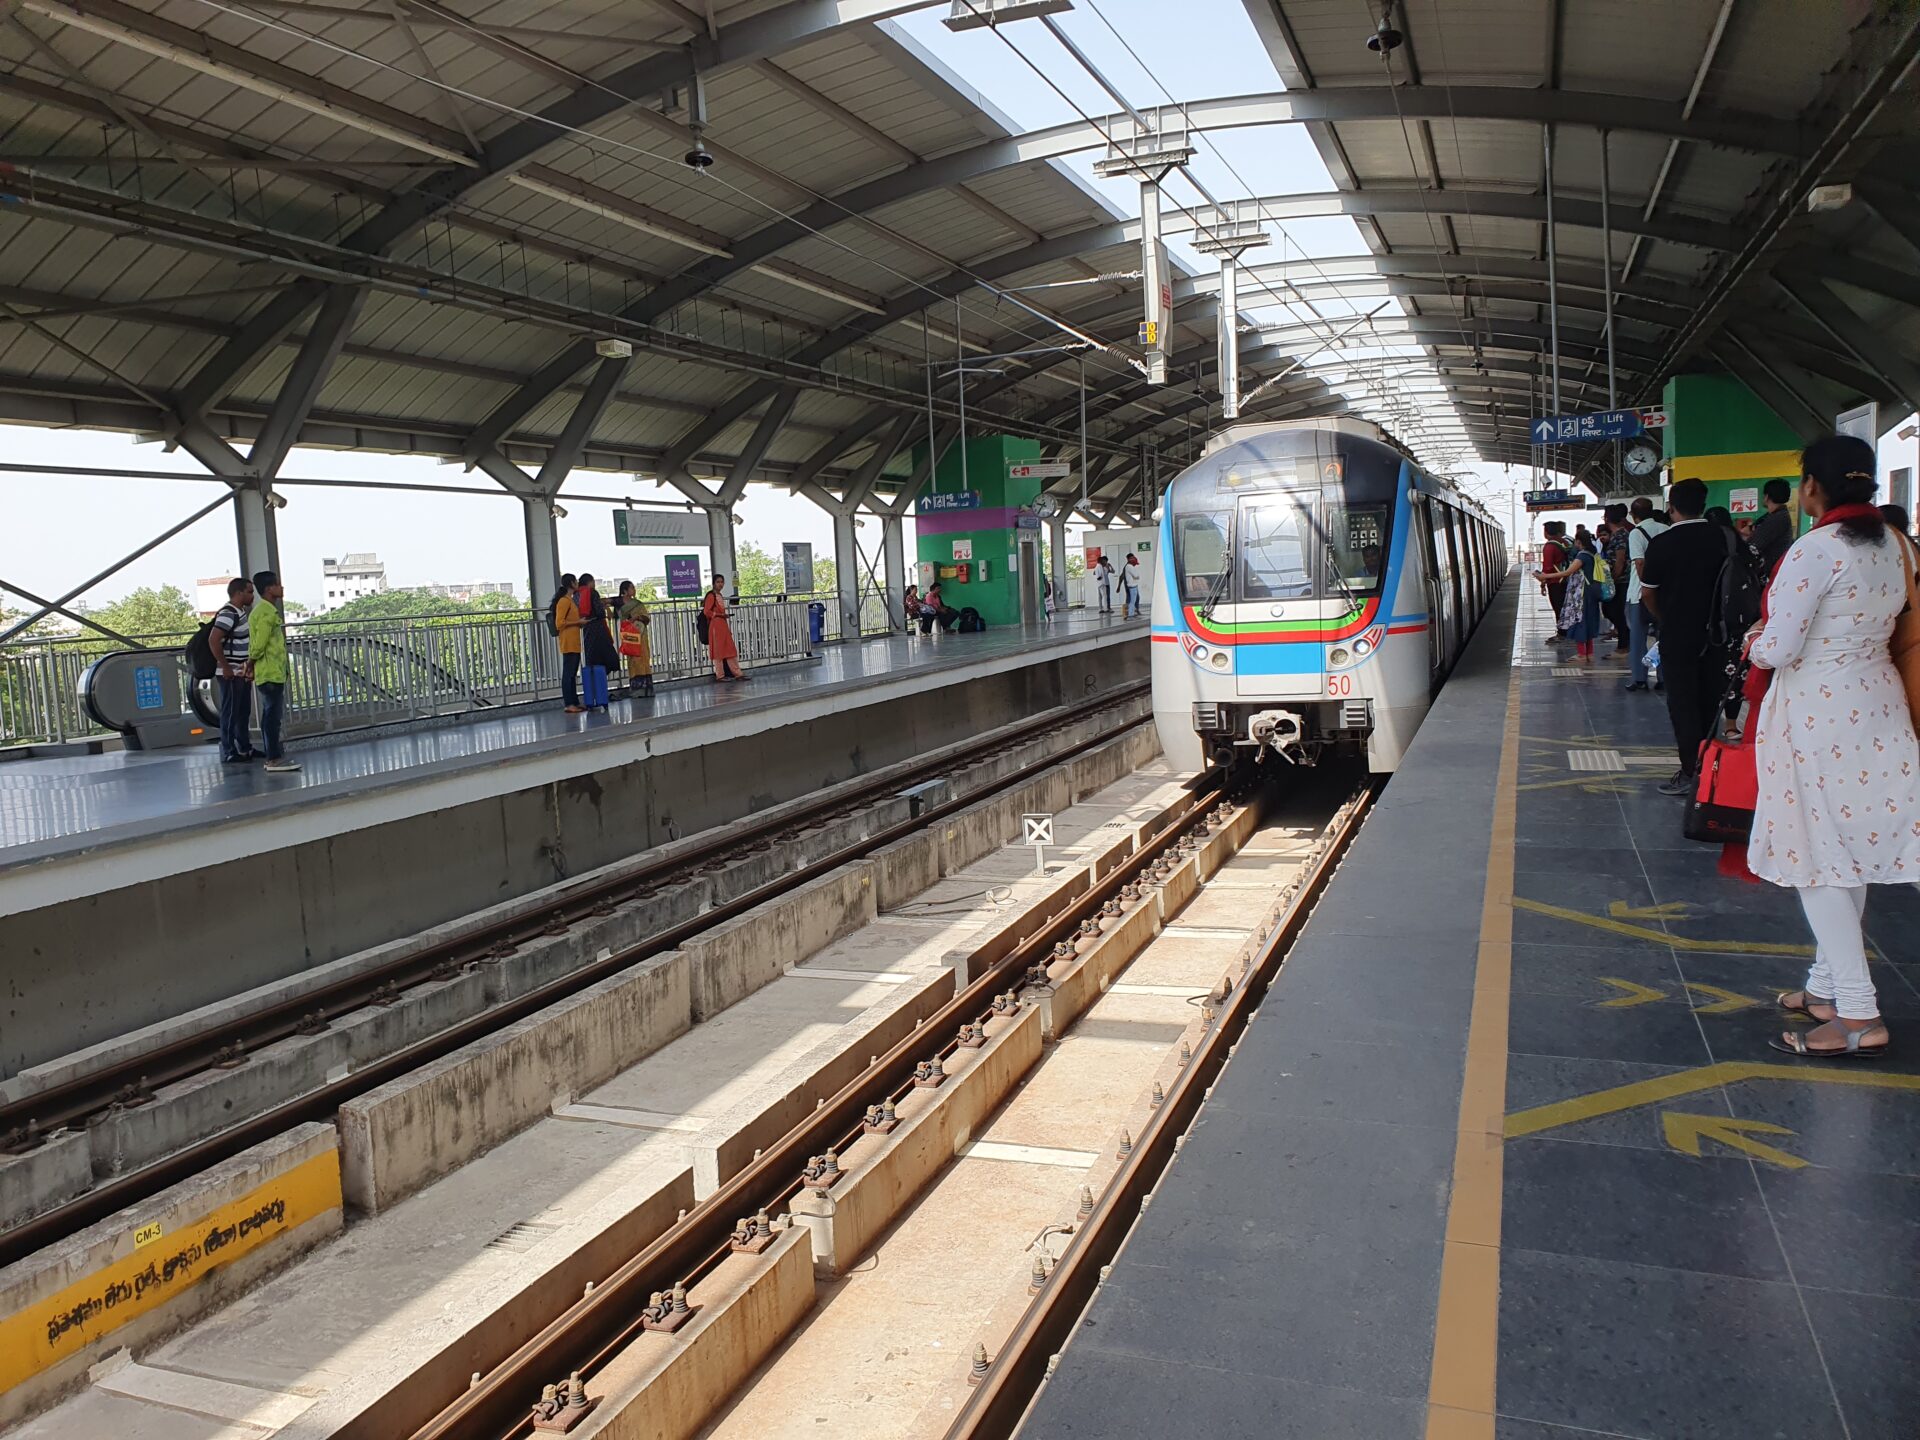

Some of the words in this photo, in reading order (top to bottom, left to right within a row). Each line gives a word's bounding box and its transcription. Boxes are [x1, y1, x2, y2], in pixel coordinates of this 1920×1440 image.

[1607, 414, 1623, 423] Lift
[1328, 675, 1350, 695] 50
[135, 1224, 161, 1244] CM-3
